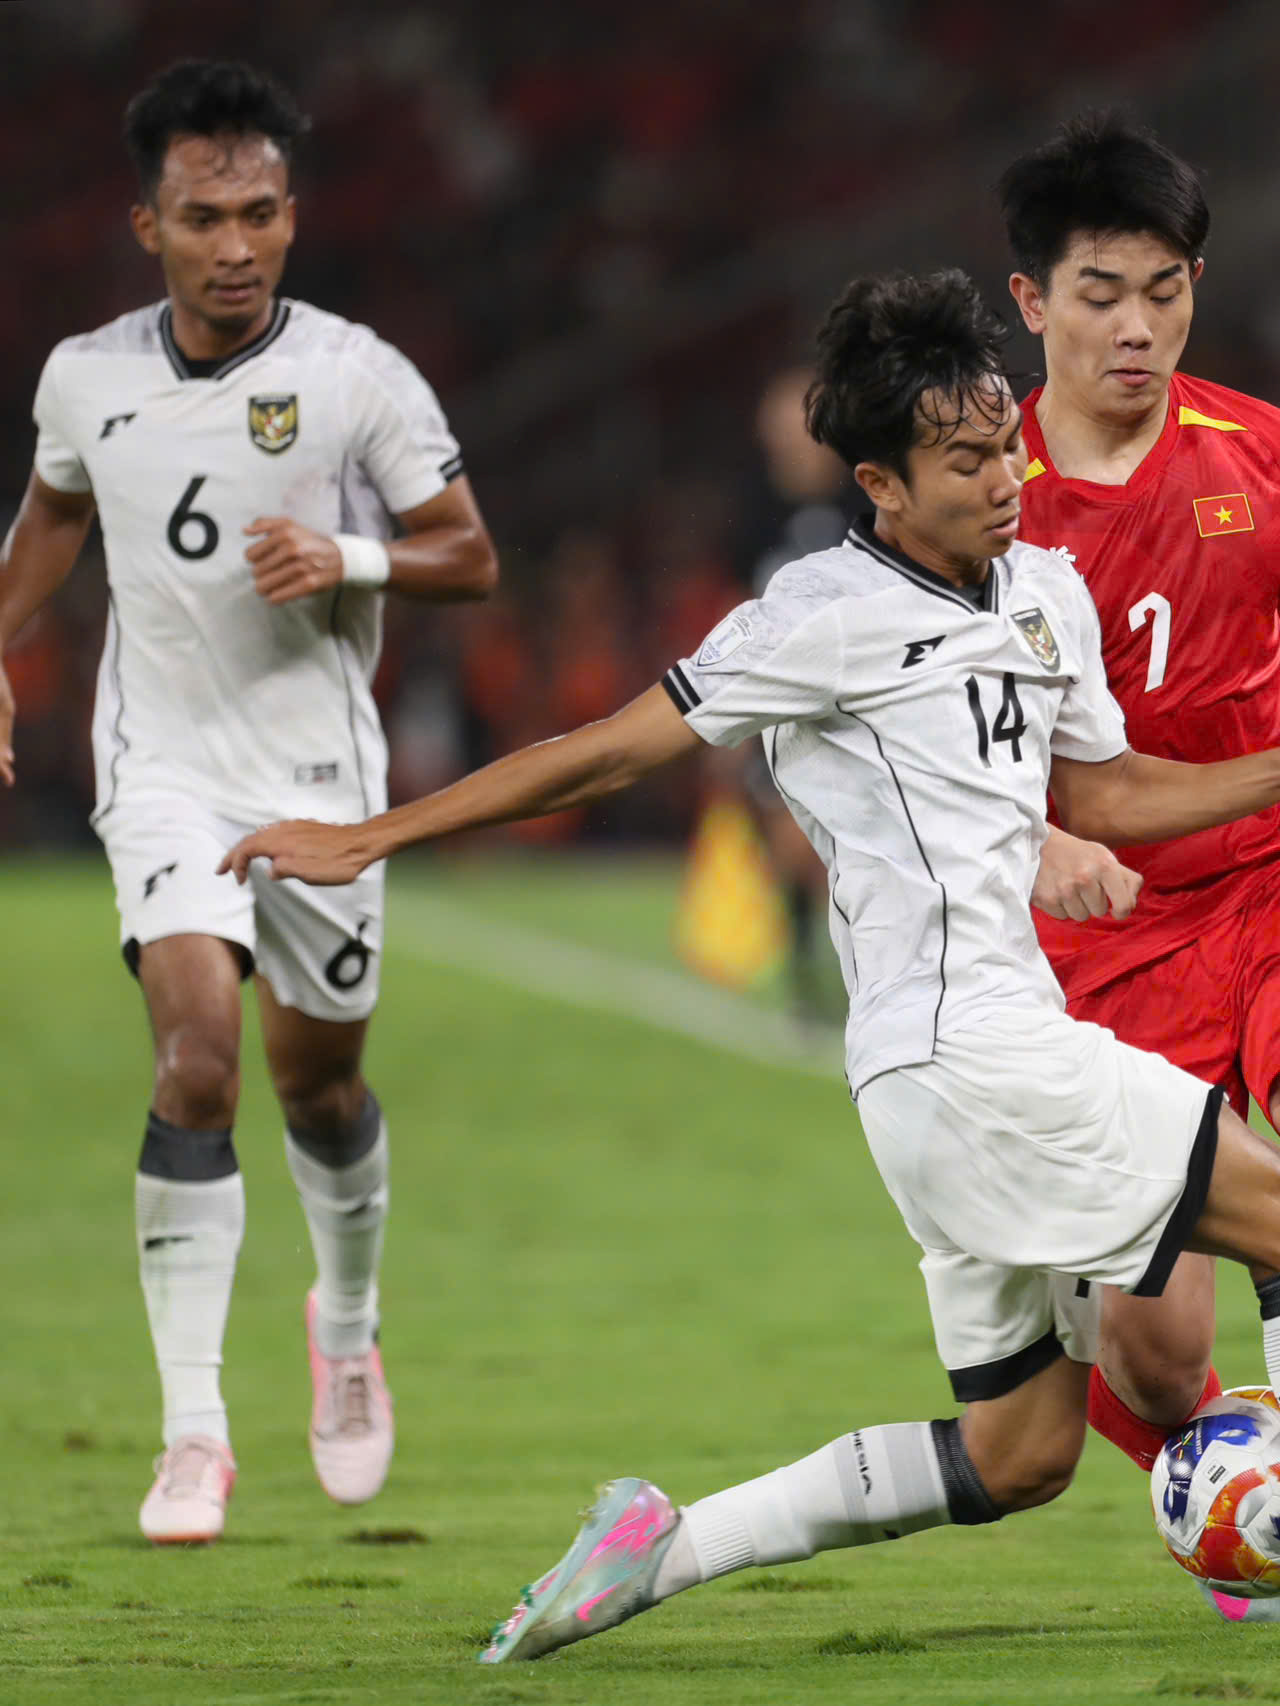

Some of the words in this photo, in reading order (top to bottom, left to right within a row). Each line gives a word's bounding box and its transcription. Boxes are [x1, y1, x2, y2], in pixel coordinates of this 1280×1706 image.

[167, 475, 219, 560] 6
[1128, 591, 1171, 693] 7
[965, 672, 1028, 769] 14
[325, 920, 369, 992] 6
